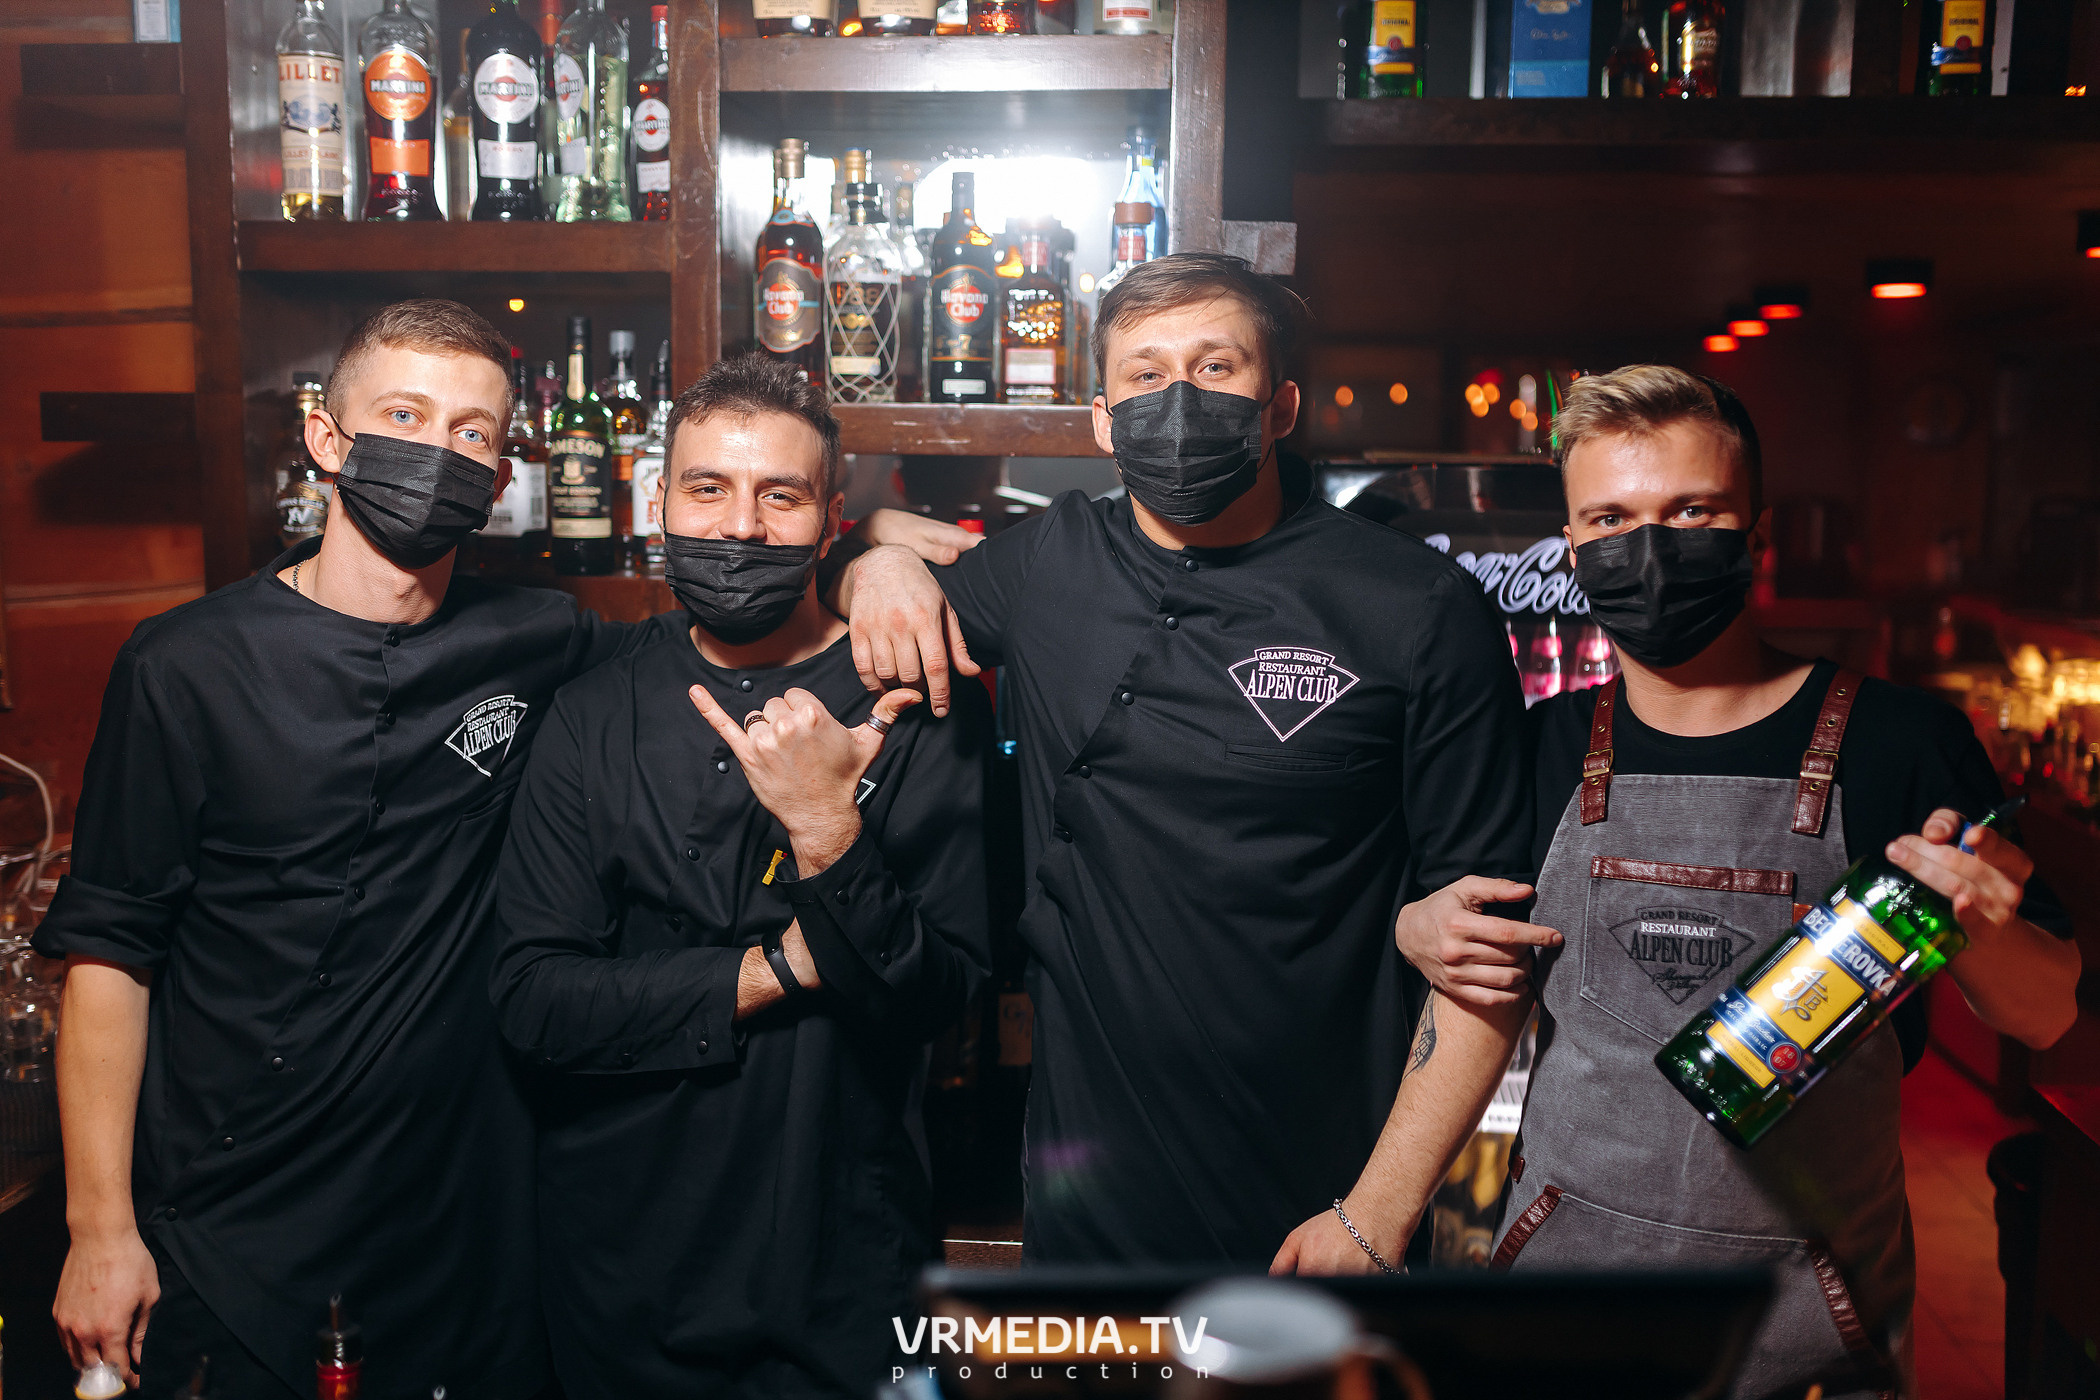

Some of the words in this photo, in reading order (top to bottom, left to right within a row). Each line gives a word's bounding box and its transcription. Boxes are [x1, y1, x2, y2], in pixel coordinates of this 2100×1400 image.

[279, 64, 340, 83] LILLET
[941, 289, 988, 303] Havana
[768, 302, 794, 315] Club
[952, 303, 979, 316] Club
[551, 438, 605, 459] AMESON
[1259, 651, 1291, 660] GRAND
[1293, 652, 1329, 666] RESORT
[1258, 661, 1326, 677] RESTAURANT
[1244, 669, 1297, 699] ALPEN
[1297, 674, 1339, 703] CLUB
[467, 705, 487, 722] GRAND
[488, 699, 511, 711] RESORT
[467, 707, 509, 732] RESTAURANT
[463, 723, 494, 759] ALPEN
[494, 710, 516, 744] CLUB
[1640, 910, 1675, 920] GRAND
[1678, 911, 1718, 926] RESORT
[1640, 921, 1716, 938] RESTAURANT
[1629, 929, 1683, 964] ALPEN
[1686, 936, 1733, 967] CLUB
[1803, 907, 1898, 997] BECEROVKA
